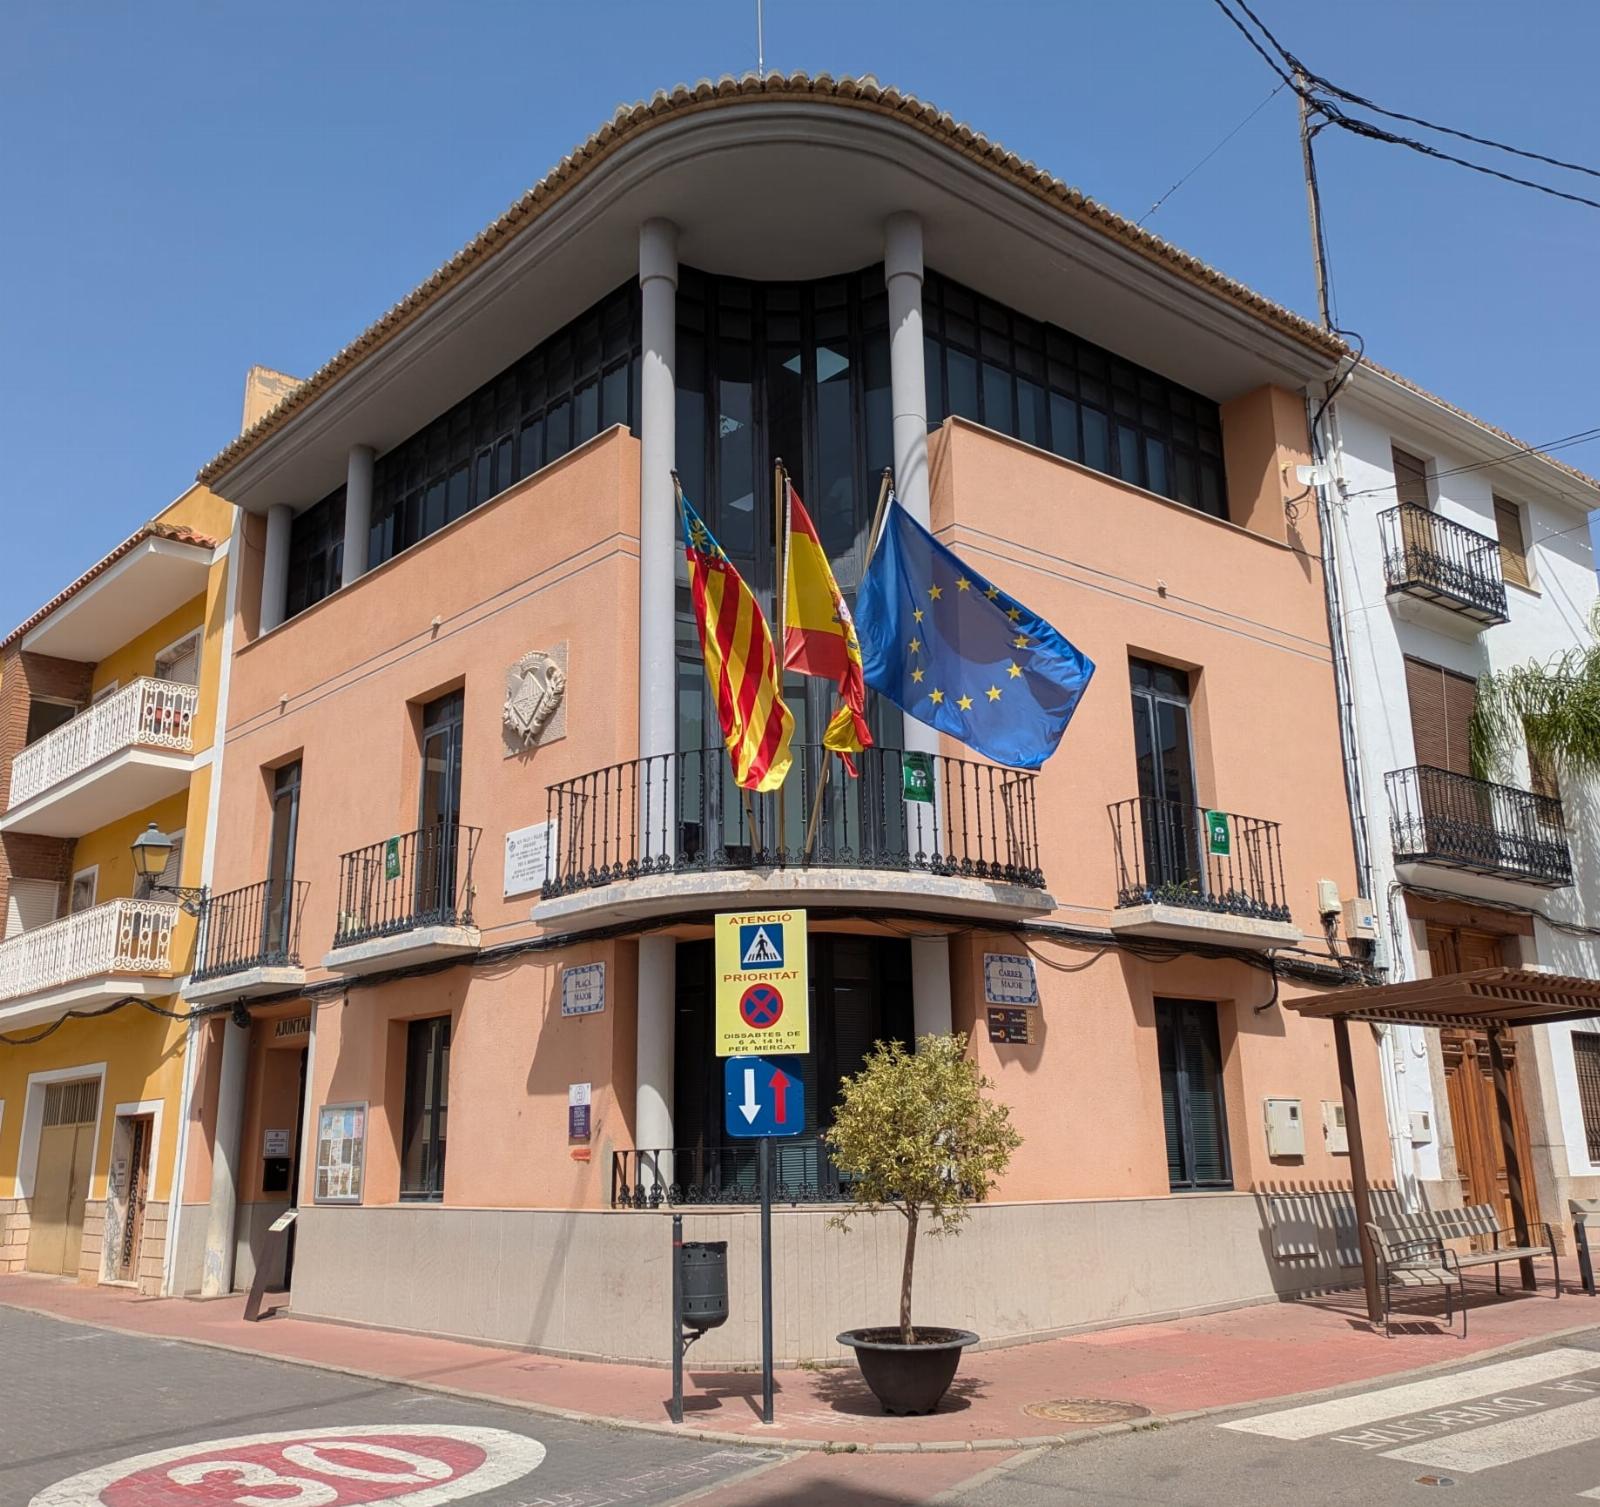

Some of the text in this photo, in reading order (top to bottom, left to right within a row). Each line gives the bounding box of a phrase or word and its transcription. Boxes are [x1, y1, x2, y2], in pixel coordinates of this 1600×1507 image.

[729, 912, 792, 925] ATENCIÓ
[723, 971, 799, 982] PRIORITAT
[998, 969, 1023, 978] CARRER
[1001, 980, 1023, 989] MAJOR
[724, 1030, 801, 1040] DISSABTES DE
[754, 1044, 797, 1052] MERCAT
[166, 1441, 454, 1507] 30
